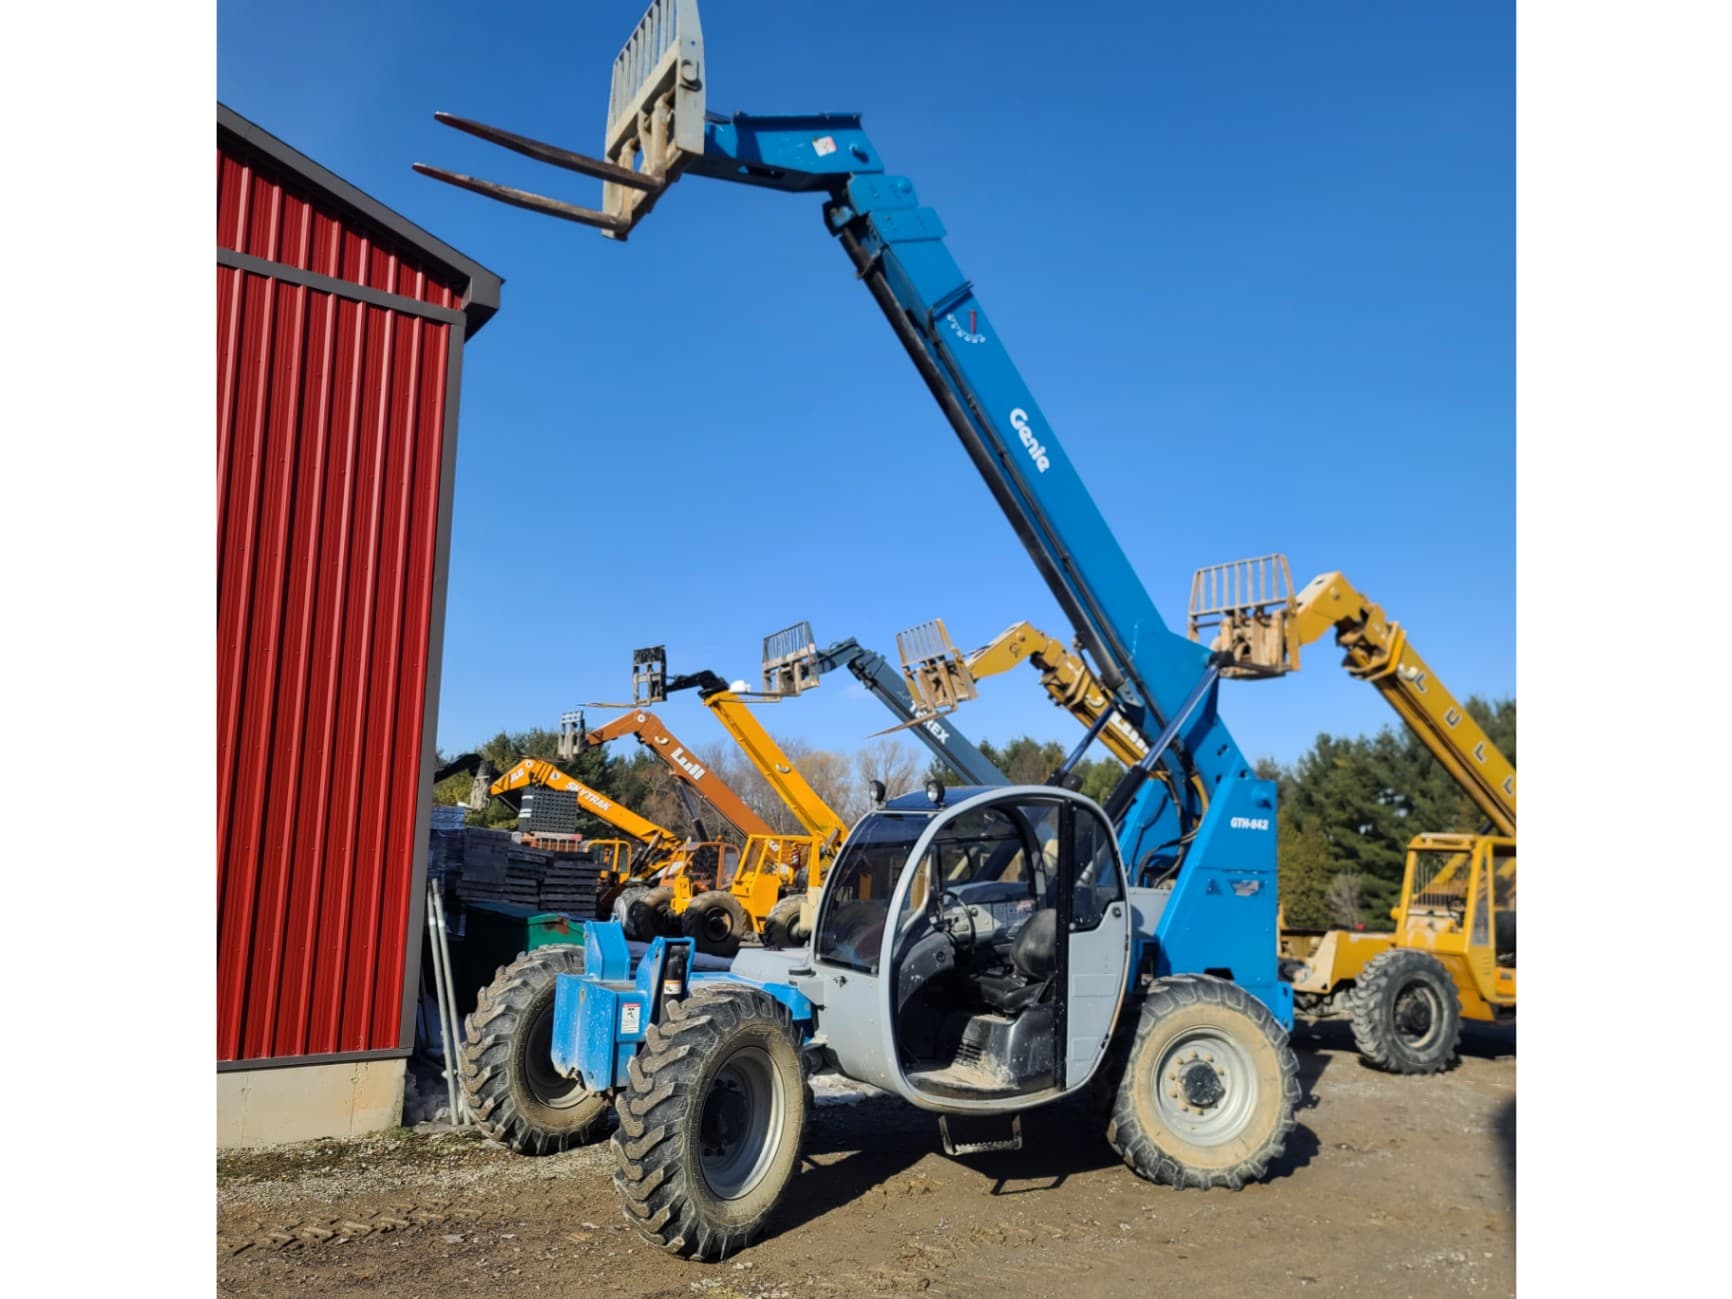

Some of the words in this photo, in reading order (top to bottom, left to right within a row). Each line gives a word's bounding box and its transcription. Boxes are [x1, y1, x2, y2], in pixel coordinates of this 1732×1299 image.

[1010, 407, 1050, 474] Genie
[671, 746, 706, 781] Lull
[565, 781, 612, 812] SKYTRAK
[1230, 816, 1269, 831] GTH-842
